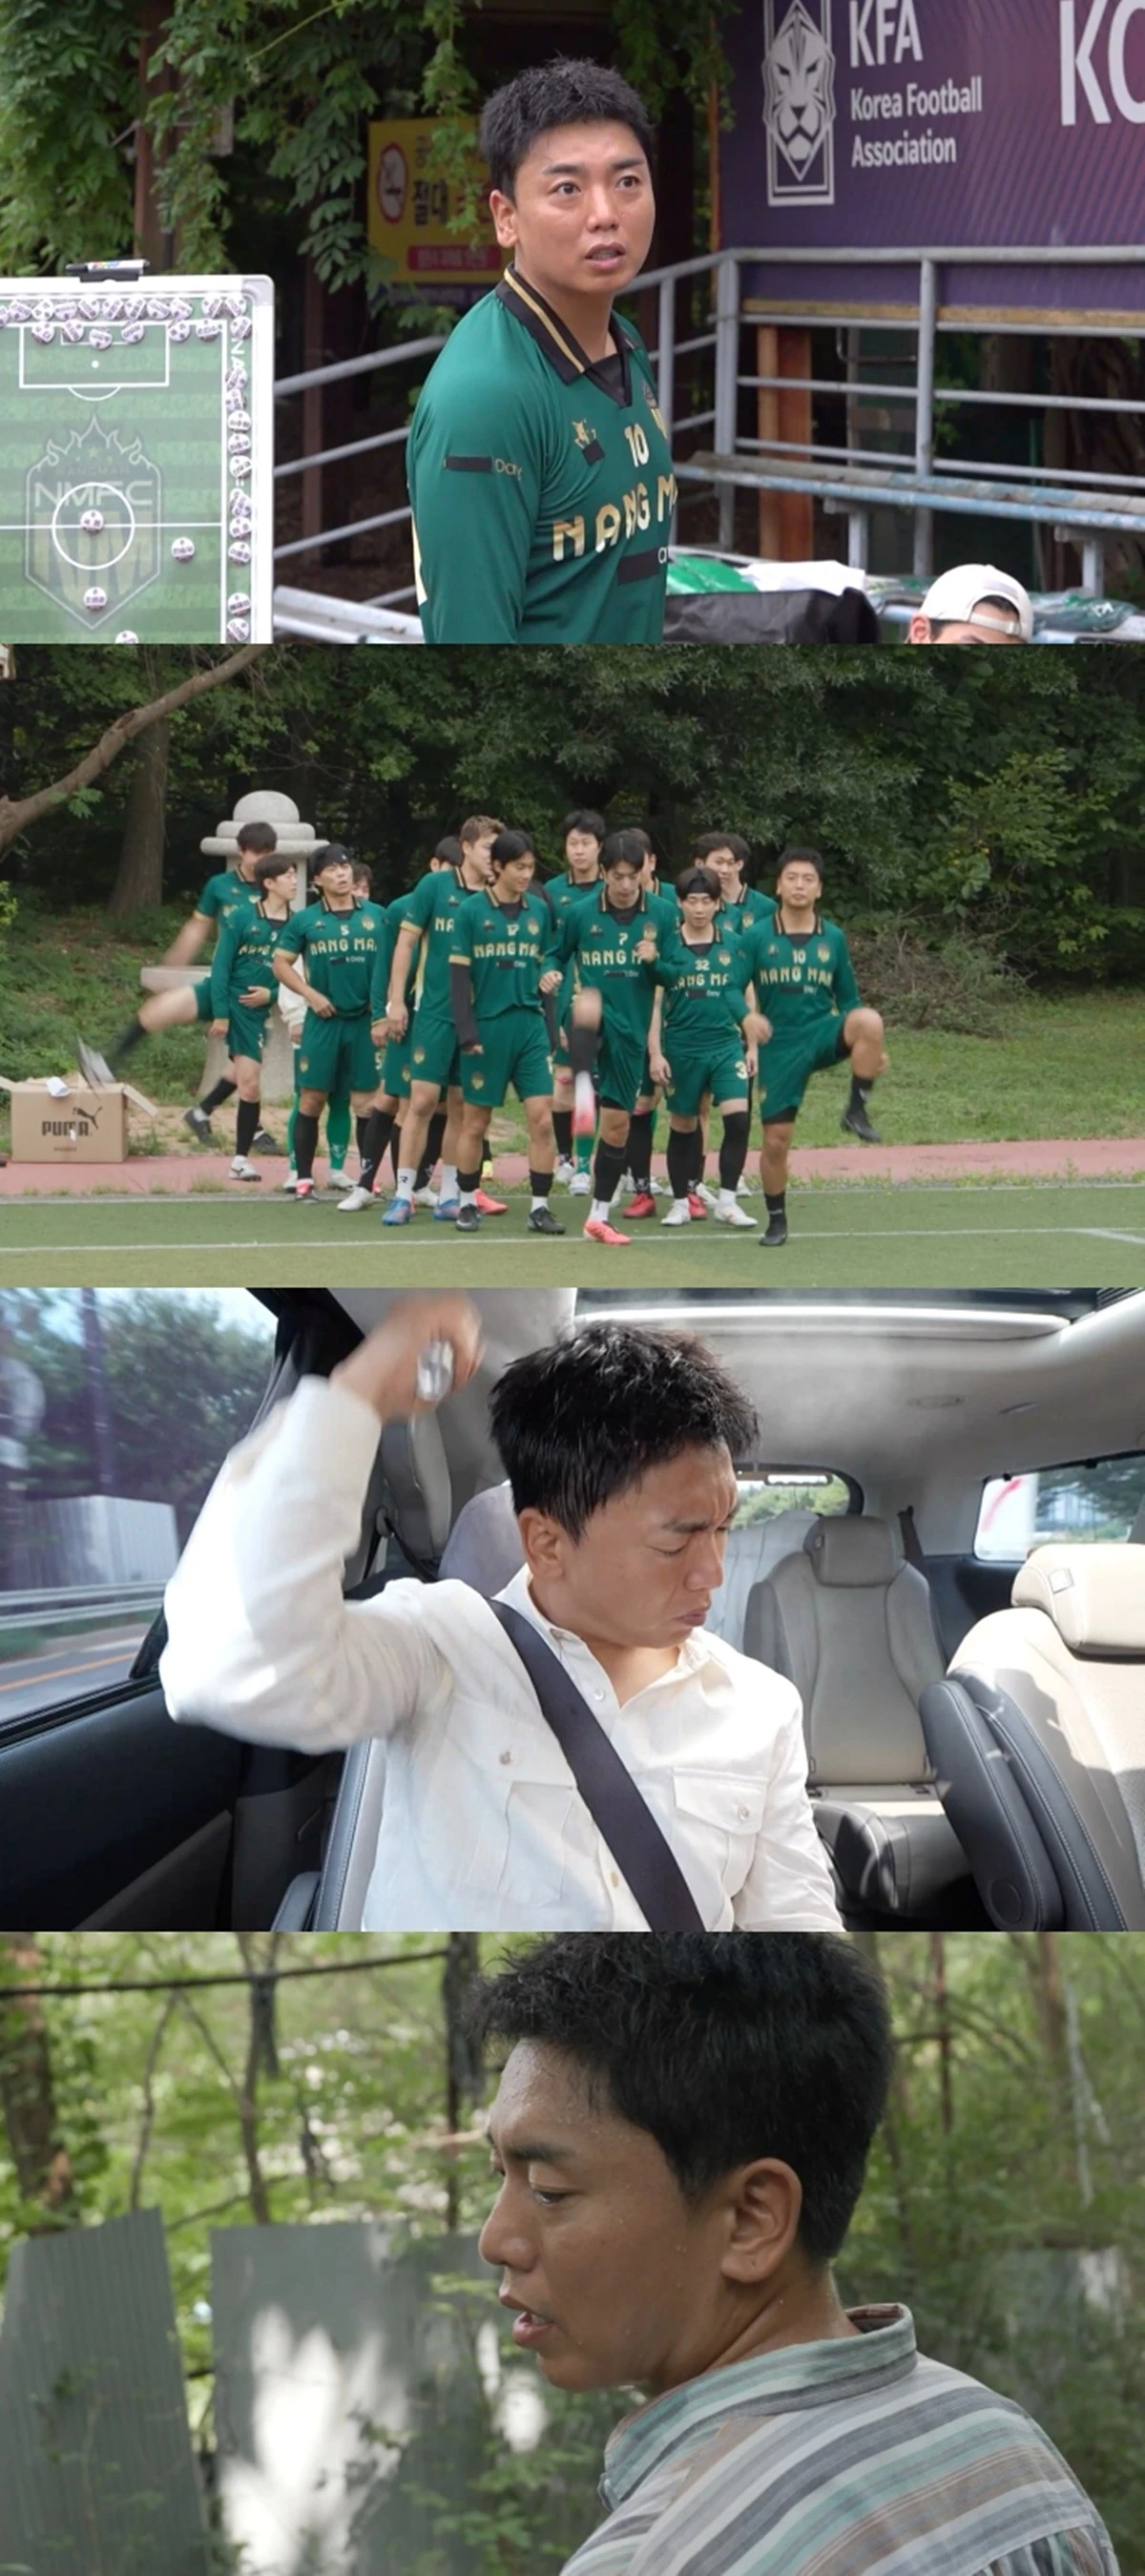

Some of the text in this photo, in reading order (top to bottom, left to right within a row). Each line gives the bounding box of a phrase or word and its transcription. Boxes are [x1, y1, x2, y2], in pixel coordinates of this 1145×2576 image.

[849, 0, 924, 68] KFA
[850, 76, 983, 121] Korea Football
[851, 130, 957, 168] Association
[624, 423, 650, 467] 10
[34, 480, 153, 508] NMFC
[552, 483, 651, 562] NANG
[340, 924, 350, 936] 5
[310, 938, 349, 955] NANG
[473, 942, 515, 958] NANG
[582, 949, 627, 966] NANG
[695, 960, 710, 971] 32
[792, 949, 807, 965] 10
[735, 1061, 748, 1080] 3
[41, 1120, 89, 1136] PUMA
